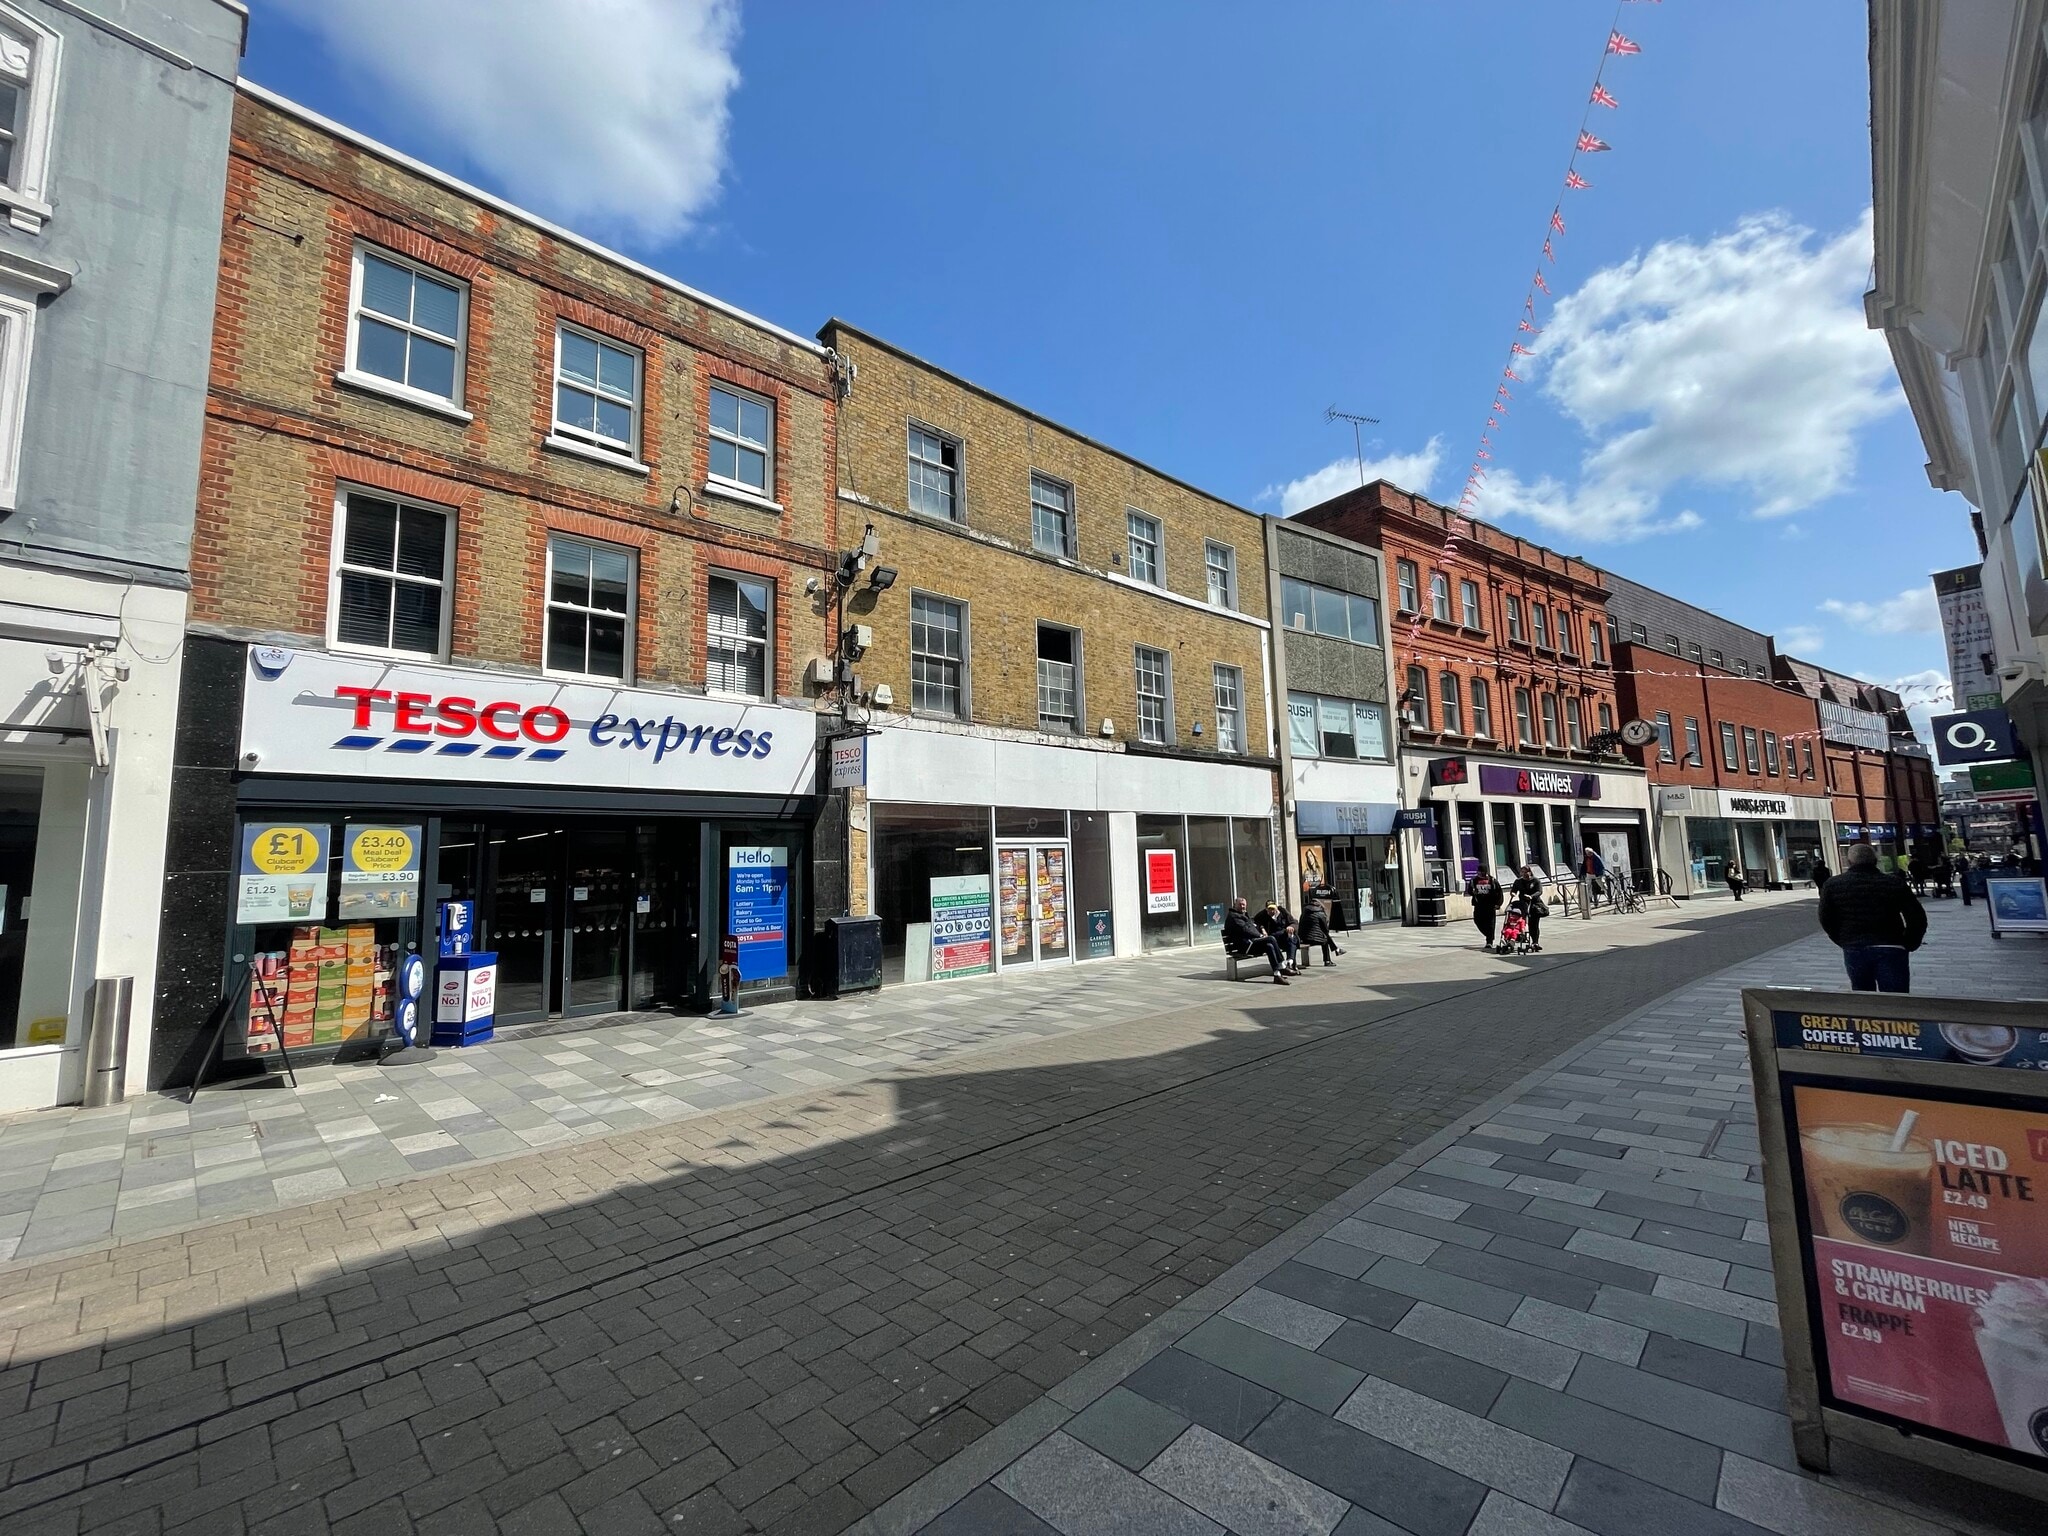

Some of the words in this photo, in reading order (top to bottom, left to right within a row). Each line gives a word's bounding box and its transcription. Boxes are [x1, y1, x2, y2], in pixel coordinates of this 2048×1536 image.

[1949, 601, 1983, 615] FOR
[1288, 704, 1312, 718] RUSH
[1356, 708, 1380, 720] RUSH
[335, 686, 571, 744] TESCO
[589, 714, 773, 764] express
[835, 748, 861, 760] TESCO
[834, 764, 861, 779] express
[1530, 772, 1573, 794] NatWest
[1336, 806, 1368, 821] RUSH
[1403, 812, 1427, 820] RUSH
[269, 833, 303, 855] £1
[361, 837, 405, 848] £3.40
[736, 851, 774, 863] Hello.
[382, 872, 414, 881] £3.90
[246, 886, 276, 894] £1.25
[735, 885, 754, 893] 6am
[762, 884, 782, 894] 11pm
[441, 997, 460, 1005] No.1
[471, 992, 492, 1009] No.1
[1800, 1015, 1848, 1030] GREAT
[1851, 1018, 1921, 1036] TASTING
[1802, 1029, 1860, 1048] COFFEE,
[1861, 1033, 1923, 1051] SIMPLE.
[1933, 1138, 2008, 1171] ICED
[1938, 1165, 2034, 1201] LATTE
[1943, 1190, 1988, 1210] £2.49
[1948, 1220, 1979, 1235] NEW
[1950, 1231, 2001, 1251] RECIPE
[1831, 1258, 1989, 1307] STRAWBERRIES
[1834, 1277, 1850, 1297] &
[1852, 1281, 1926, 1313] CREAM
[1839, 1303, 1915, 1337] FRAPPÉ
[1841, 1322, 1883, 1344] £2.99
